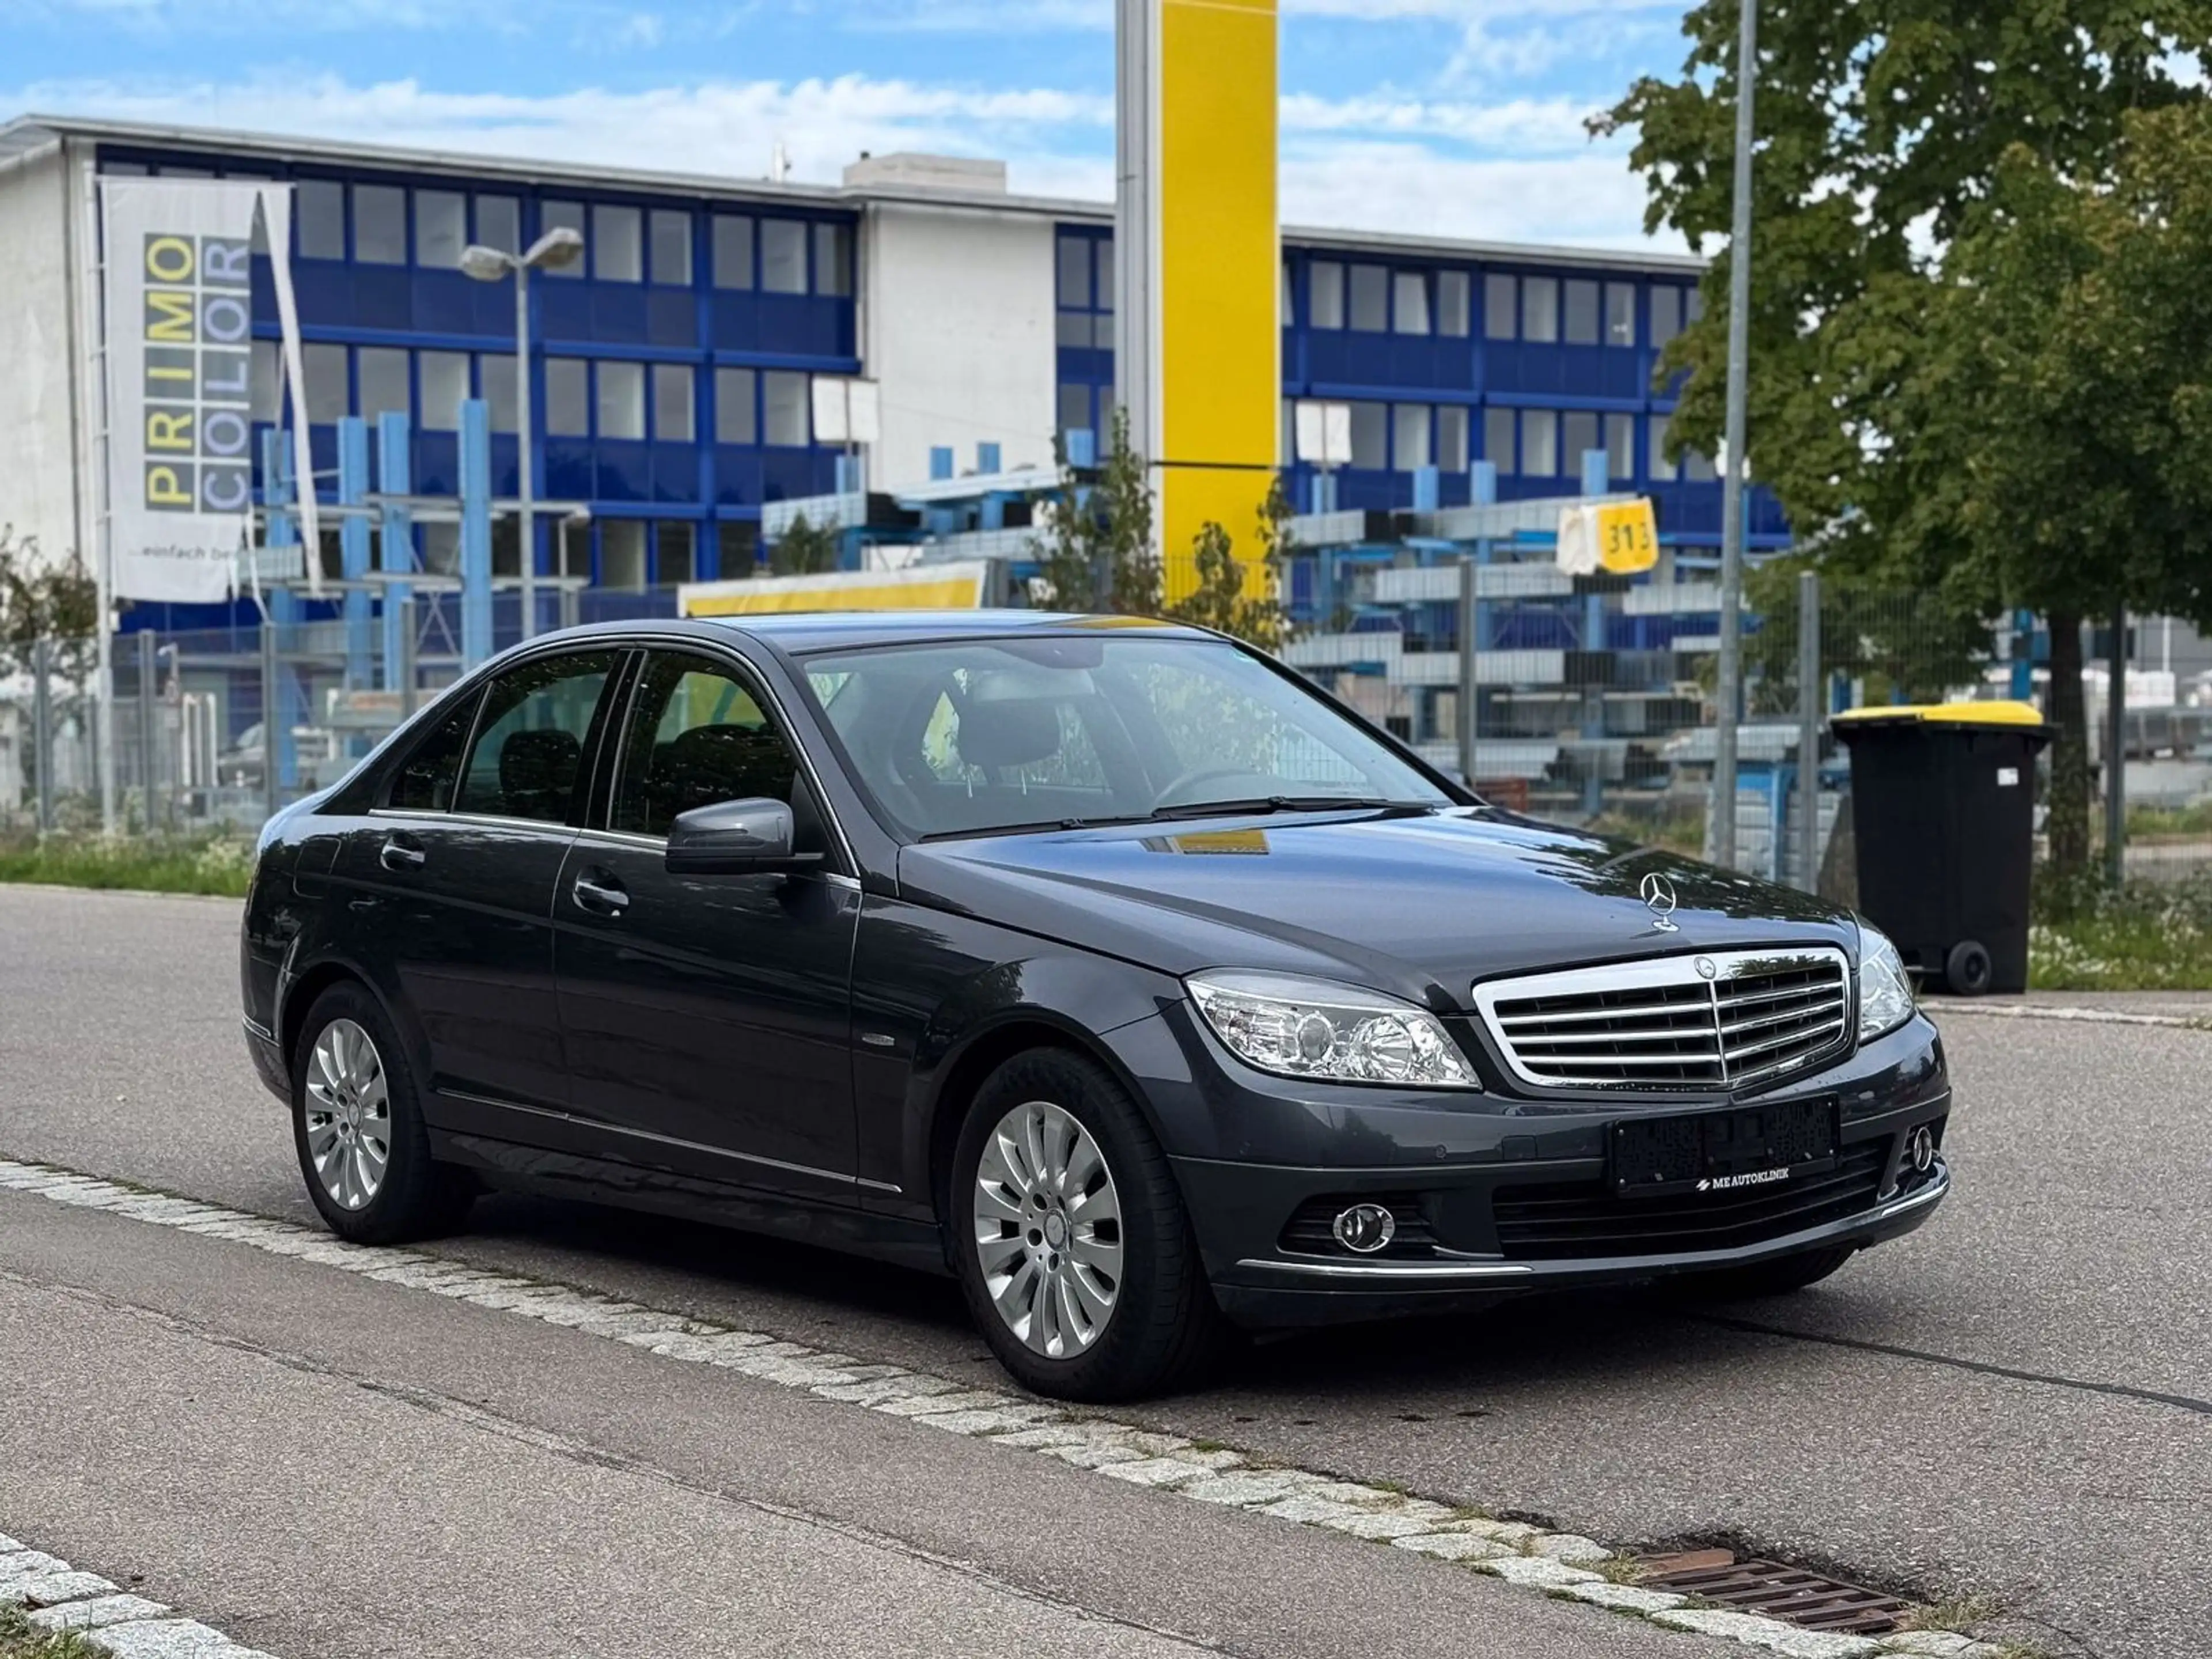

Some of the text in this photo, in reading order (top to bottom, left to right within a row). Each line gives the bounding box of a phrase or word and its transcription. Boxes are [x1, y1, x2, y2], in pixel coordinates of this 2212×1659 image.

[146, 236, 195, 505] PRIMO
[204, 242, 248, 510] COLOR
[1608, 522, 1651, 554] 313
